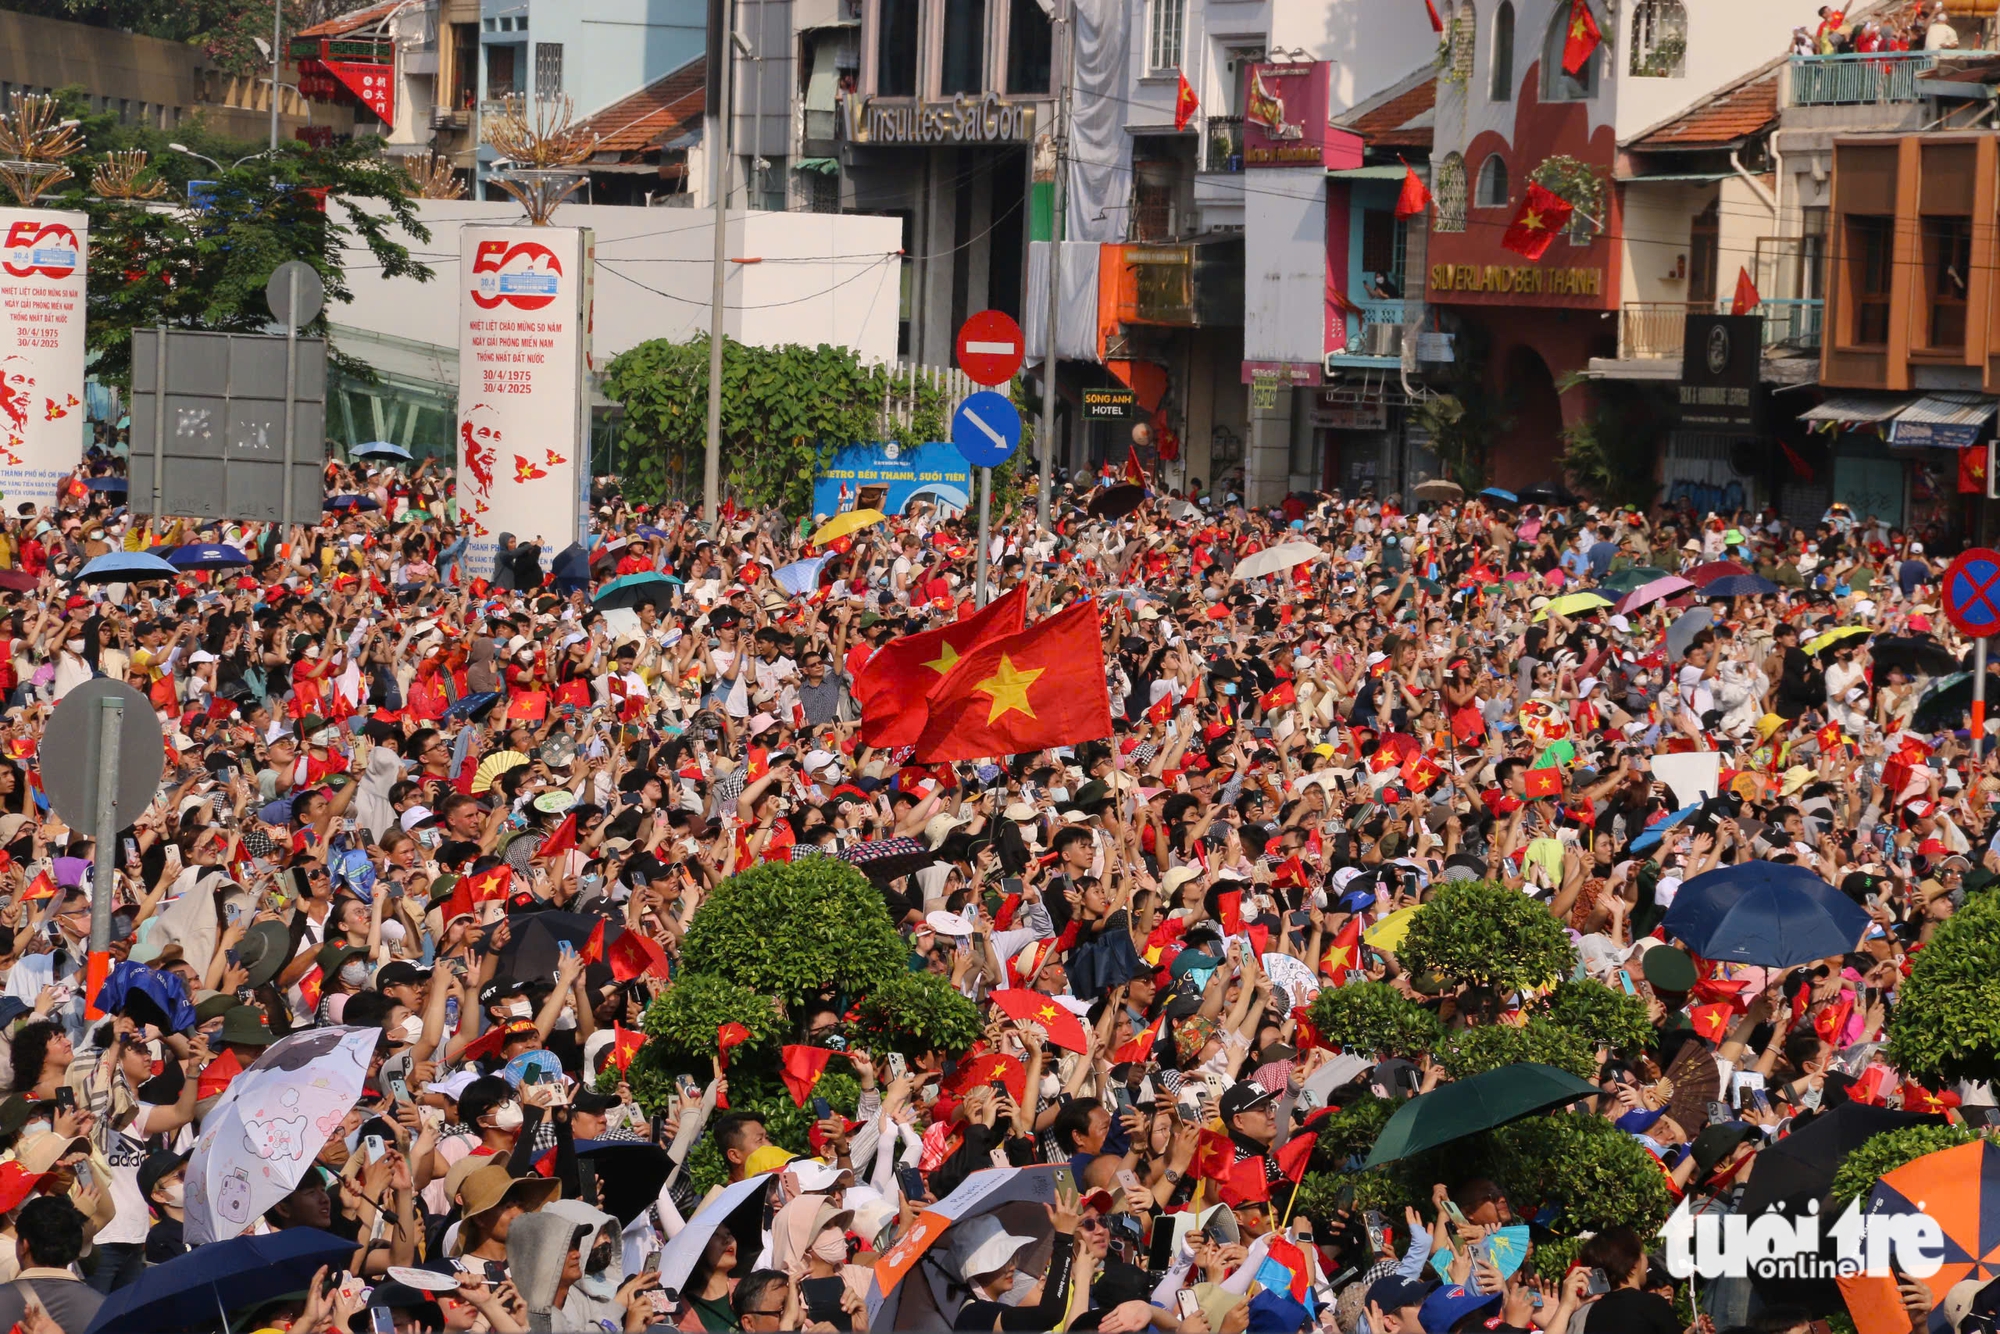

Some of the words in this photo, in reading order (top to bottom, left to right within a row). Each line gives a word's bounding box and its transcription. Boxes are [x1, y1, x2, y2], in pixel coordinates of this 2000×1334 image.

[13, 252, 29, 260] 30.4
[480, 278, 496, 287] 30.4
[1431, 264, 1511, 292] SILVERLAND
[64, 302, 74, 311] NAM
[537, 323, 546, 332] 50
[17, 328, 58, 338] 30/4/1975
[17, 338, 59, 348] 30/4/2025
[539, 339, 554, 348] NAM
[484, 370, 531, 380] 30/4/1975
[484, 383, 532, 394] 30/4/2025
[1112, 396, 1132, 404] ANH
[1092, 406, 1124, 415] HOTEL
[820, 470, 855, 478] METRO
[490, 544, 500, 552] PH
